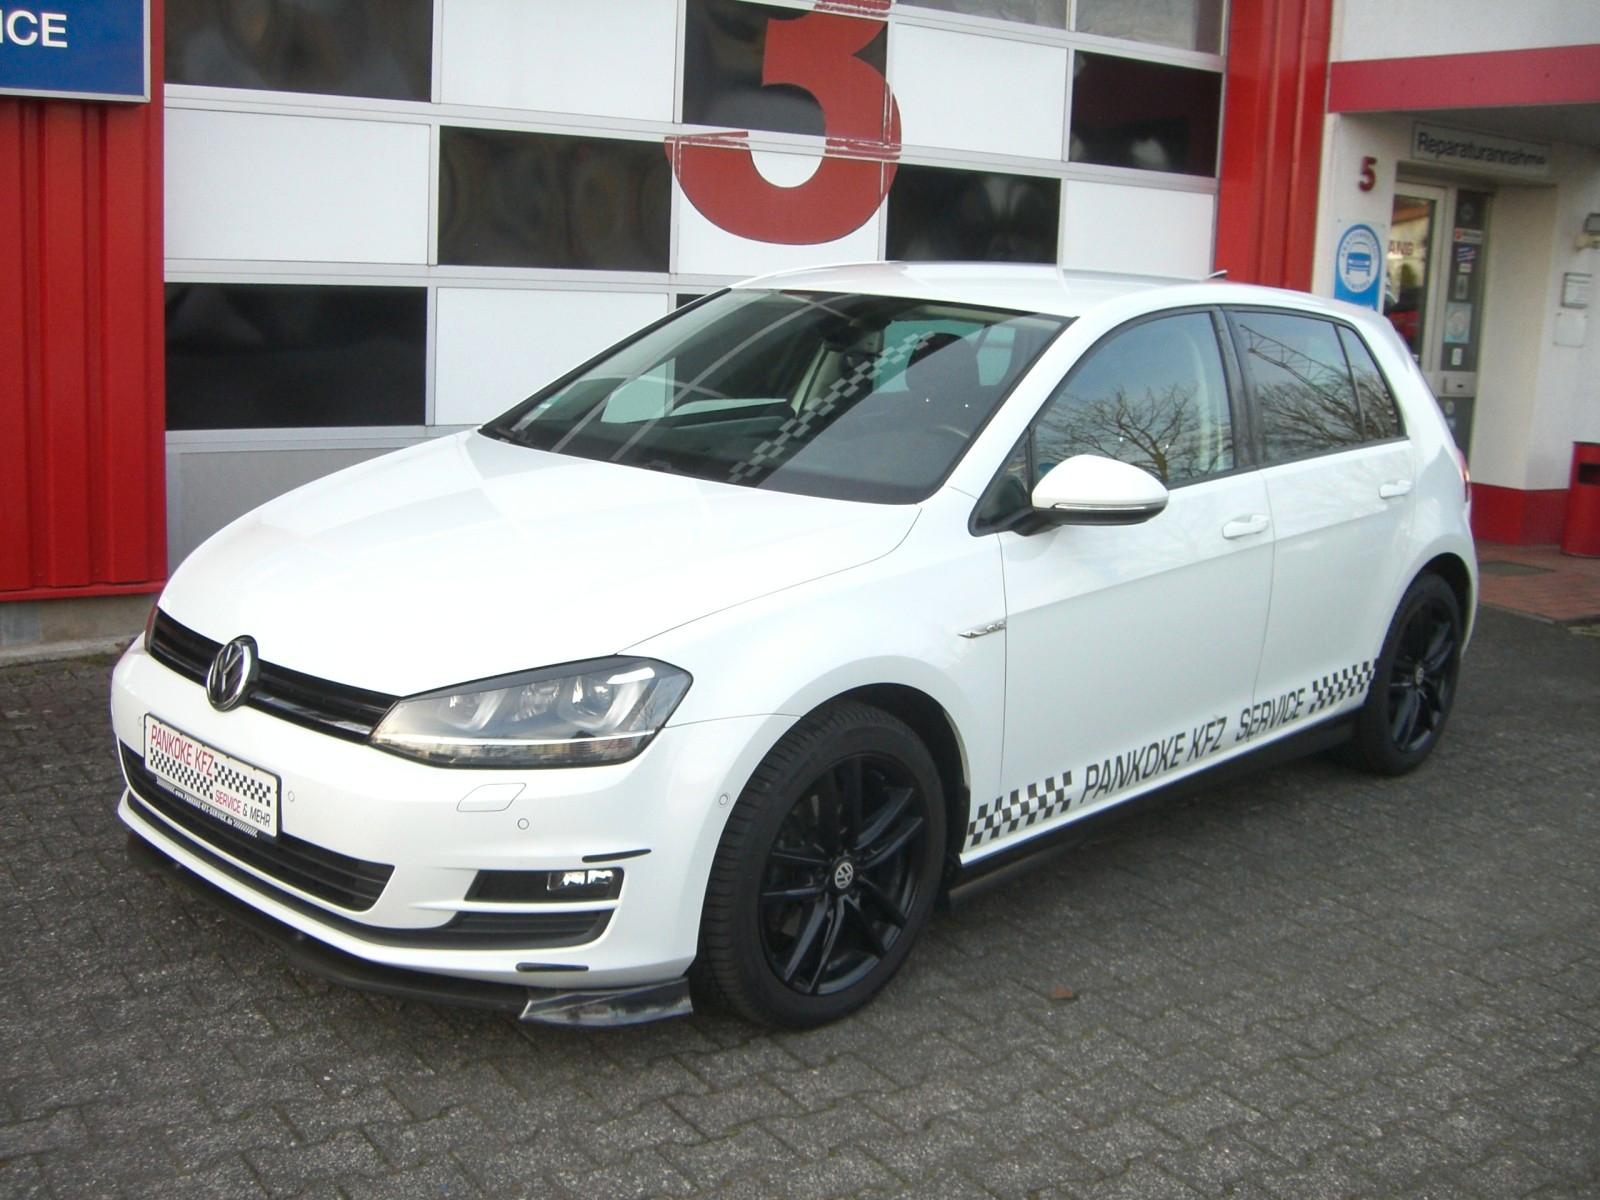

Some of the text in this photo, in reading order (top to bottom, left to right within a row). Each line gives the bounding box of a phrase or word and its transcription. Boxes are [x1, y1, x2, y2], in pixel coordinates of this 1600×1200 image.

[664, 0, 902, 246] 3
[1358, 156, 1377, 192] 5
[150, 725, 214, 778] PANKOKE KFZ
[1080, 688, 1306, 804] PANKOKE KFZ SERVICE
[215, 789, 241, 814] SERVICE
[242, 803, 248, 817] &
[250, 806, 271, 827] MEHR
